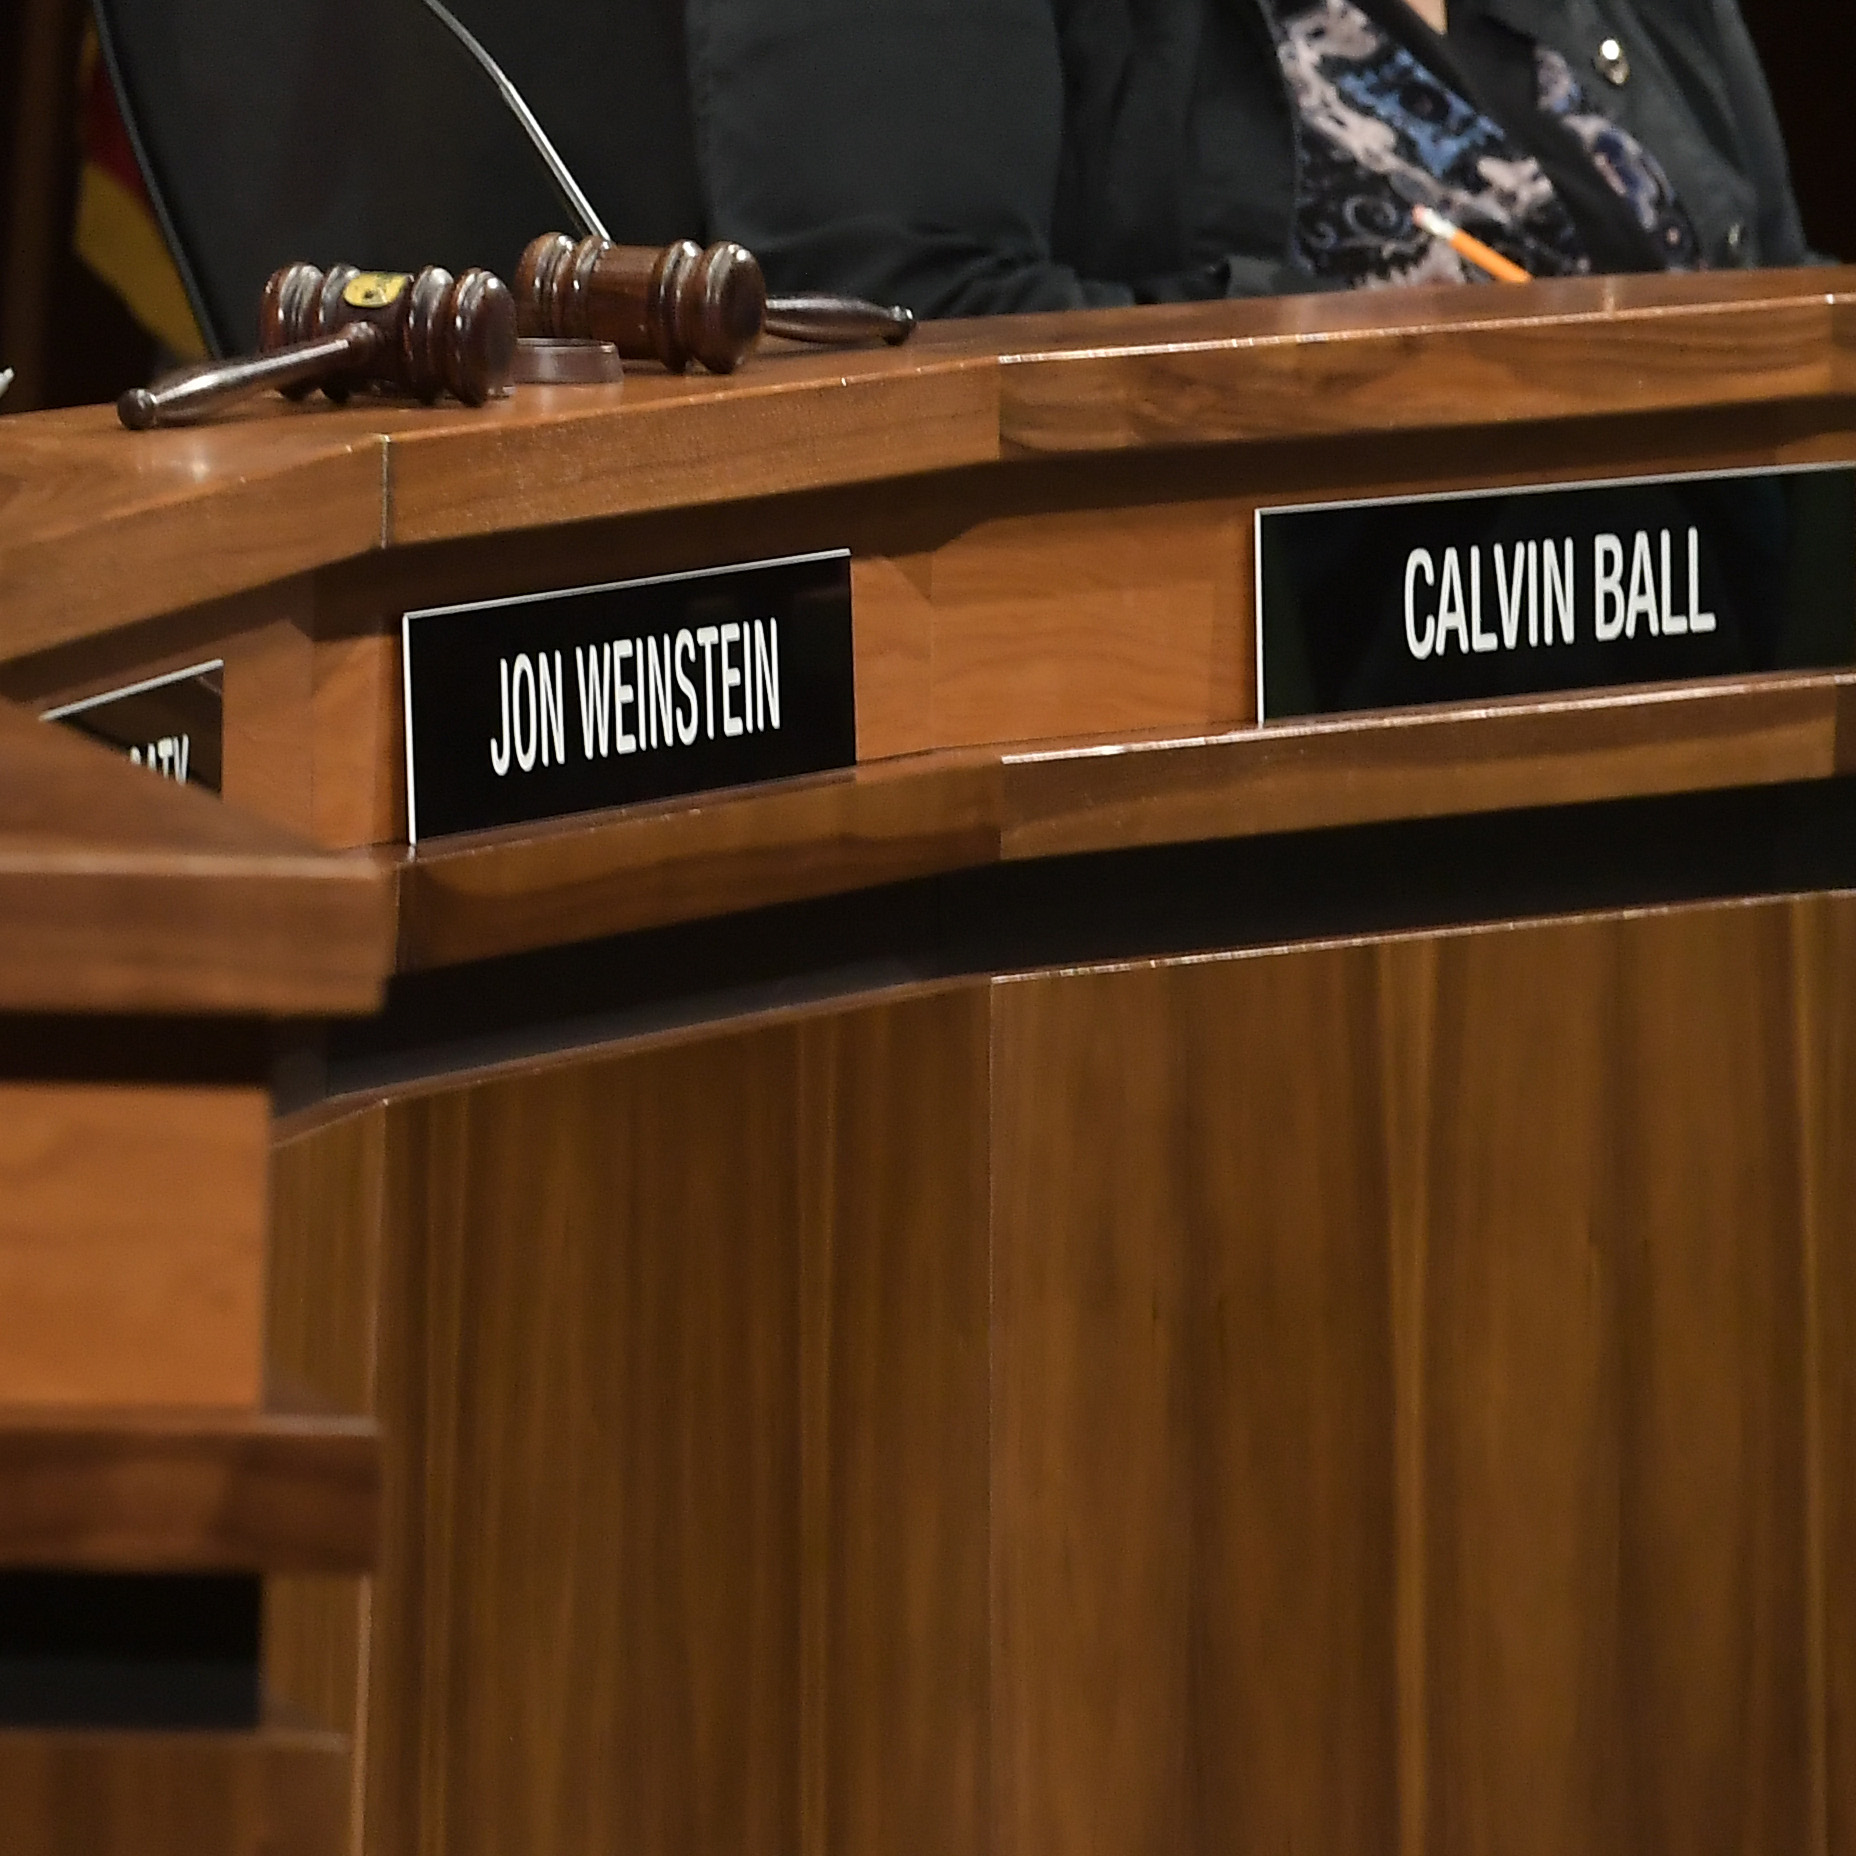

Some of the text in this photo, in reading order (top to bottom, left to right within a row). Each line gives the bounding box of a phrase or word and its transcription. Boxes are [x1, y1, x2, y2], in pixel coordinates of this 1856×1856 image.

[1403, 526, 1718, 661] CALVIN BALL
[489, 616, 782, 777] JON WEINSTEIN
